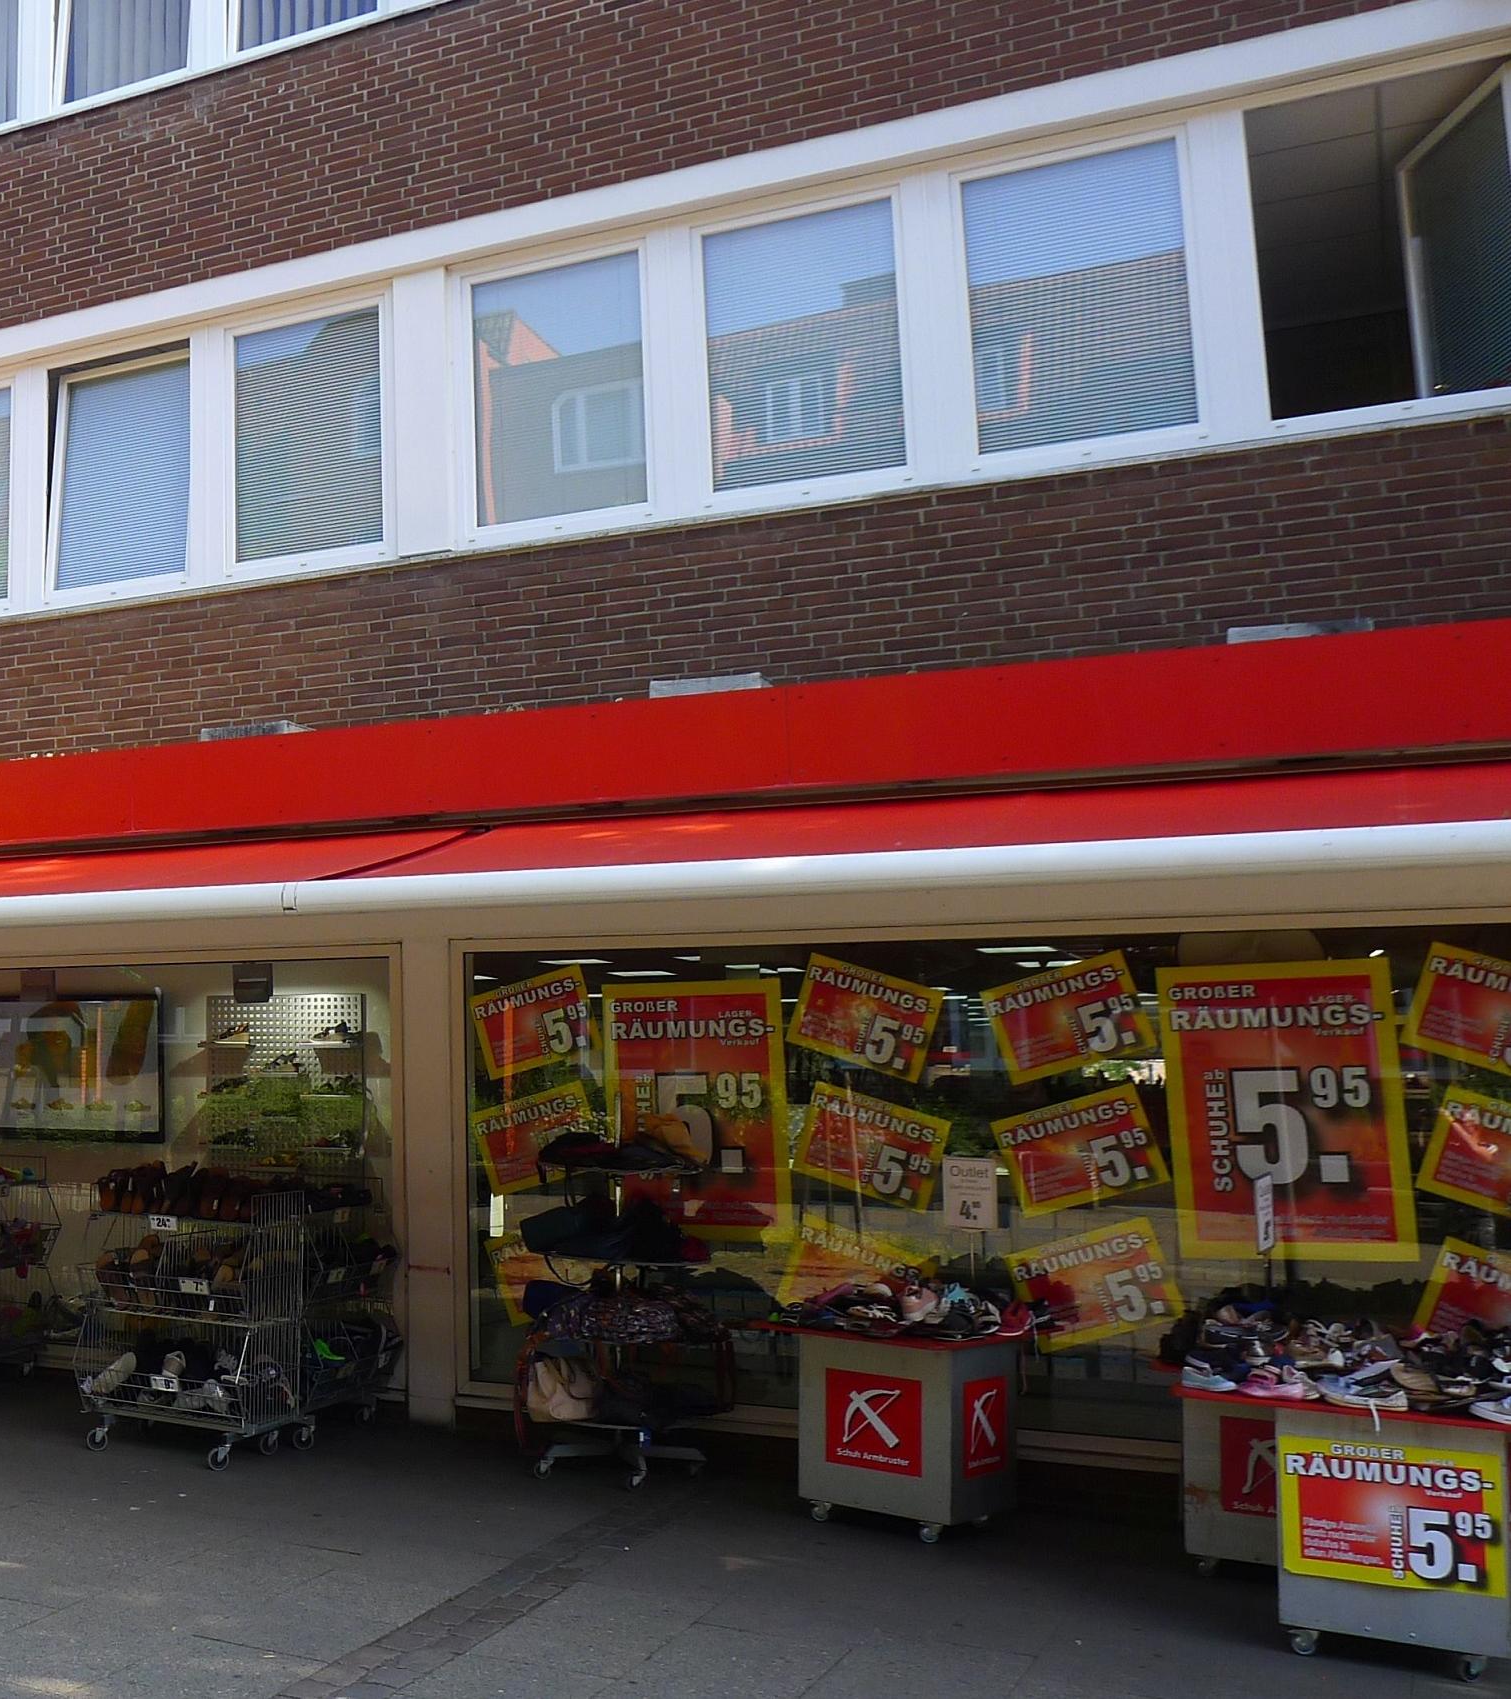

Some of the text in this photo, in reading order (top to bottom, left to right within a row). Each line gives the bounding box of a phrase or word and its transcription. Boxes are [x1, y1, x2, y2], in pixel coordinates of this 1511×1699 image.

[610, 999, 679, 1014] GROßER
[1168, 983, 1257, 1001] GROßER
[1169, 1003, 1385, 1031] RÄUMUNGS-
[610, 1016, 775, 1041] RÄUMUNGS-
[864, 1014, 926, 1071] 5.95
[1077, 992, 1137, 1053] 5.95
[1204, 1083, 1234, 1192] SCHUHE
[1231, 1065, 1371, 1185] 5.95
[1090, 1127, 1149, 1188] 5.95
[1105, 1261, 1163, 1323] 5.95
[1285, 1452, 1494, 1492] RÄUMUNGS-
[1406, 1506, 1493, 1583] 5.95
